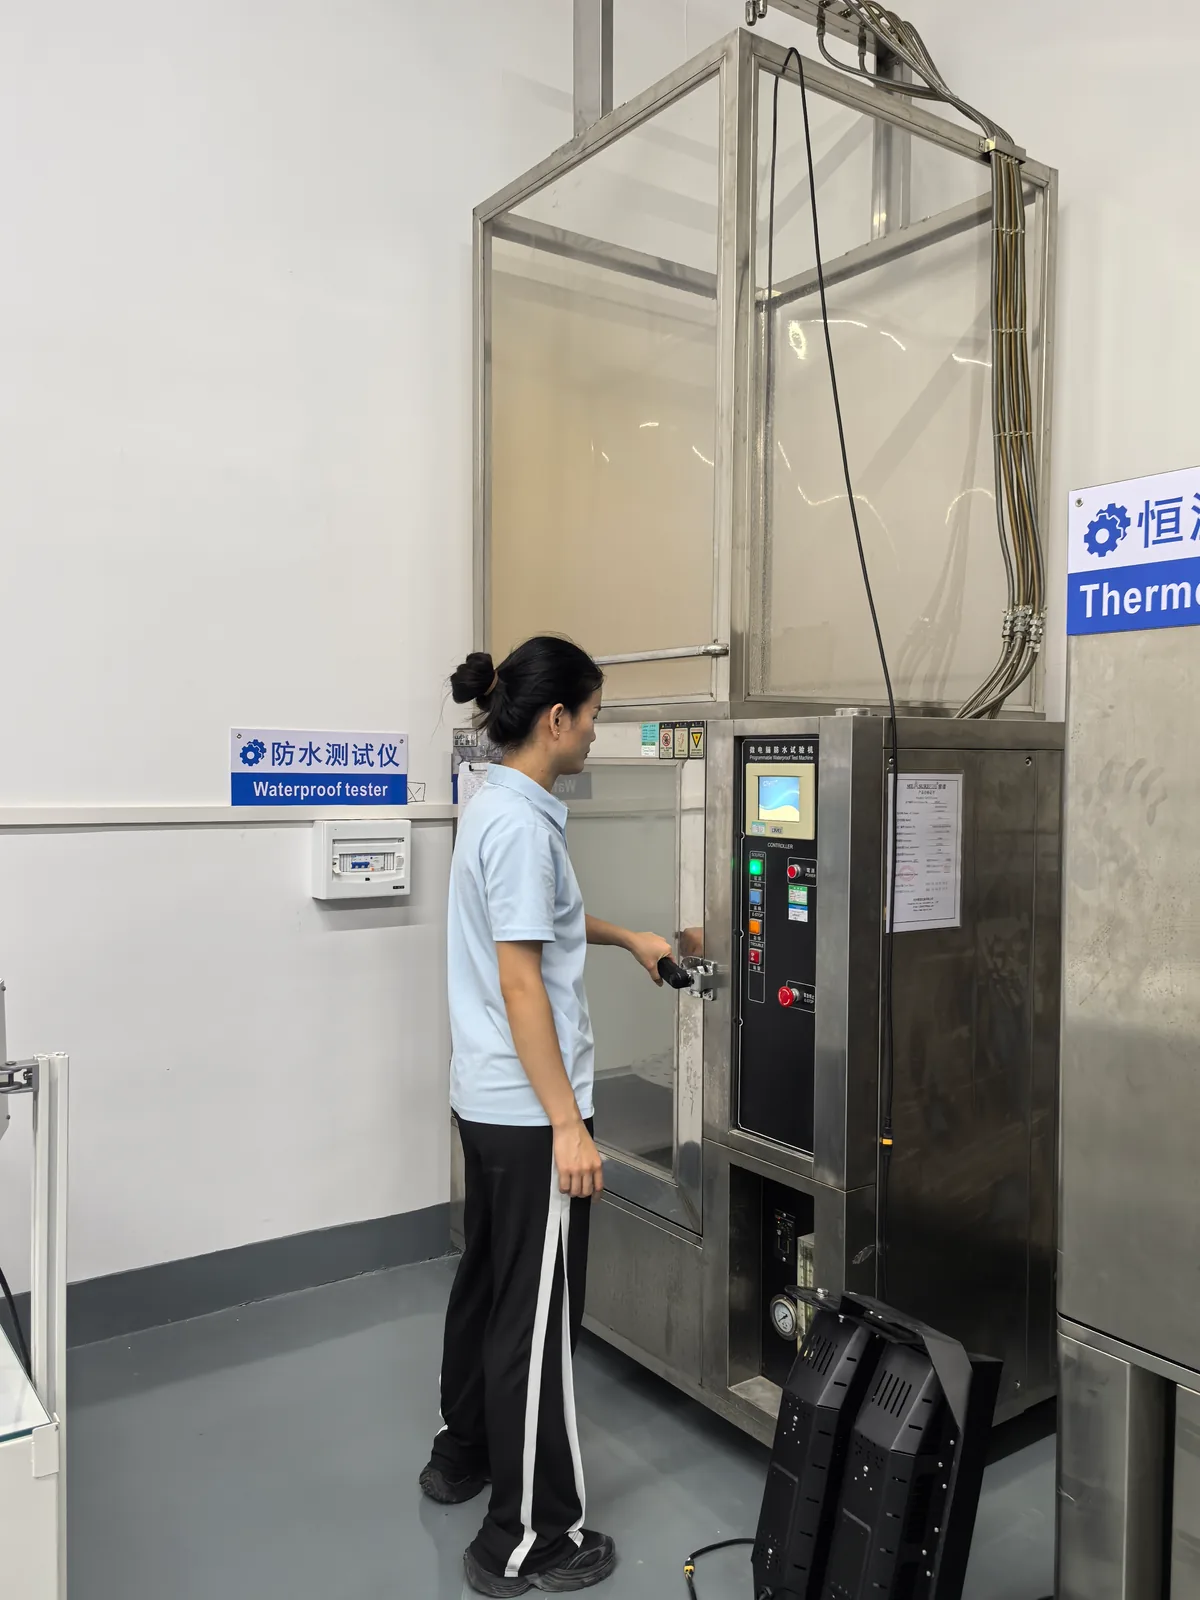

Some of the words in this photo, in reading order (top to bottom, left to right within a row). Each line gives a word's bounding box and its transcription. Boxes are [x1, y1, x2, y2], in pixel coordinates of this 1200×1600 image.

[1079, 581, 1200, 618] Therm
[271, 740, 400, 768] 防水测试仪
[253, 780, 342, 801] Waterproof
[345, 782, 388, 797] tester
